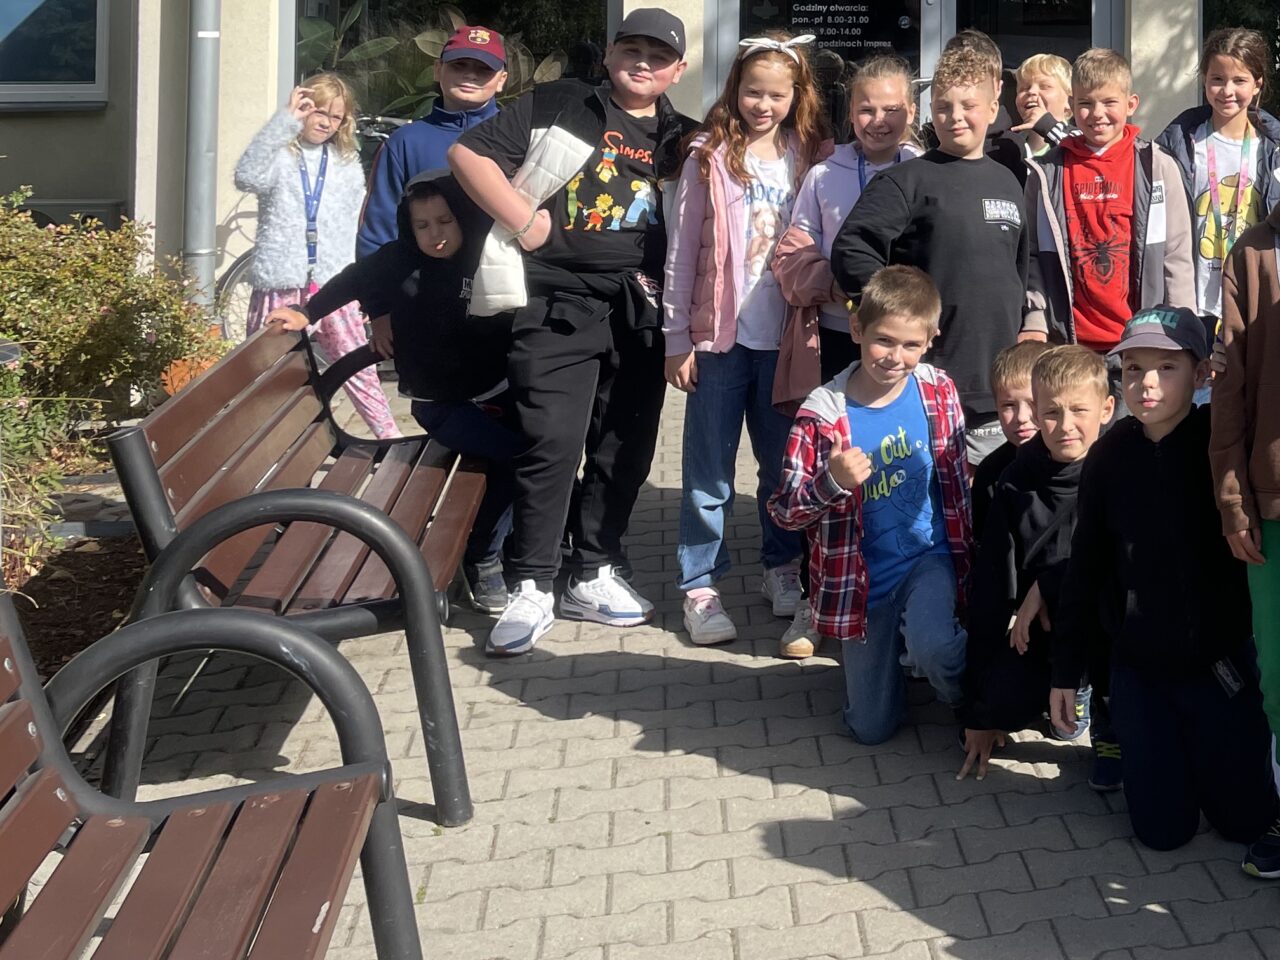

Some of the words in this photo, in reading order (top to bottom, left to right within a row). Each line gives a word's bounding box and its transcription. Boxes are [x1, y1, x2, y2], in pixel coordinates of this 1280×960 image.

[792, 3, 828, 13] Godziny
[818, 39, 862, 49] godzinach
[603, 130, 654, 165] SIMPS
